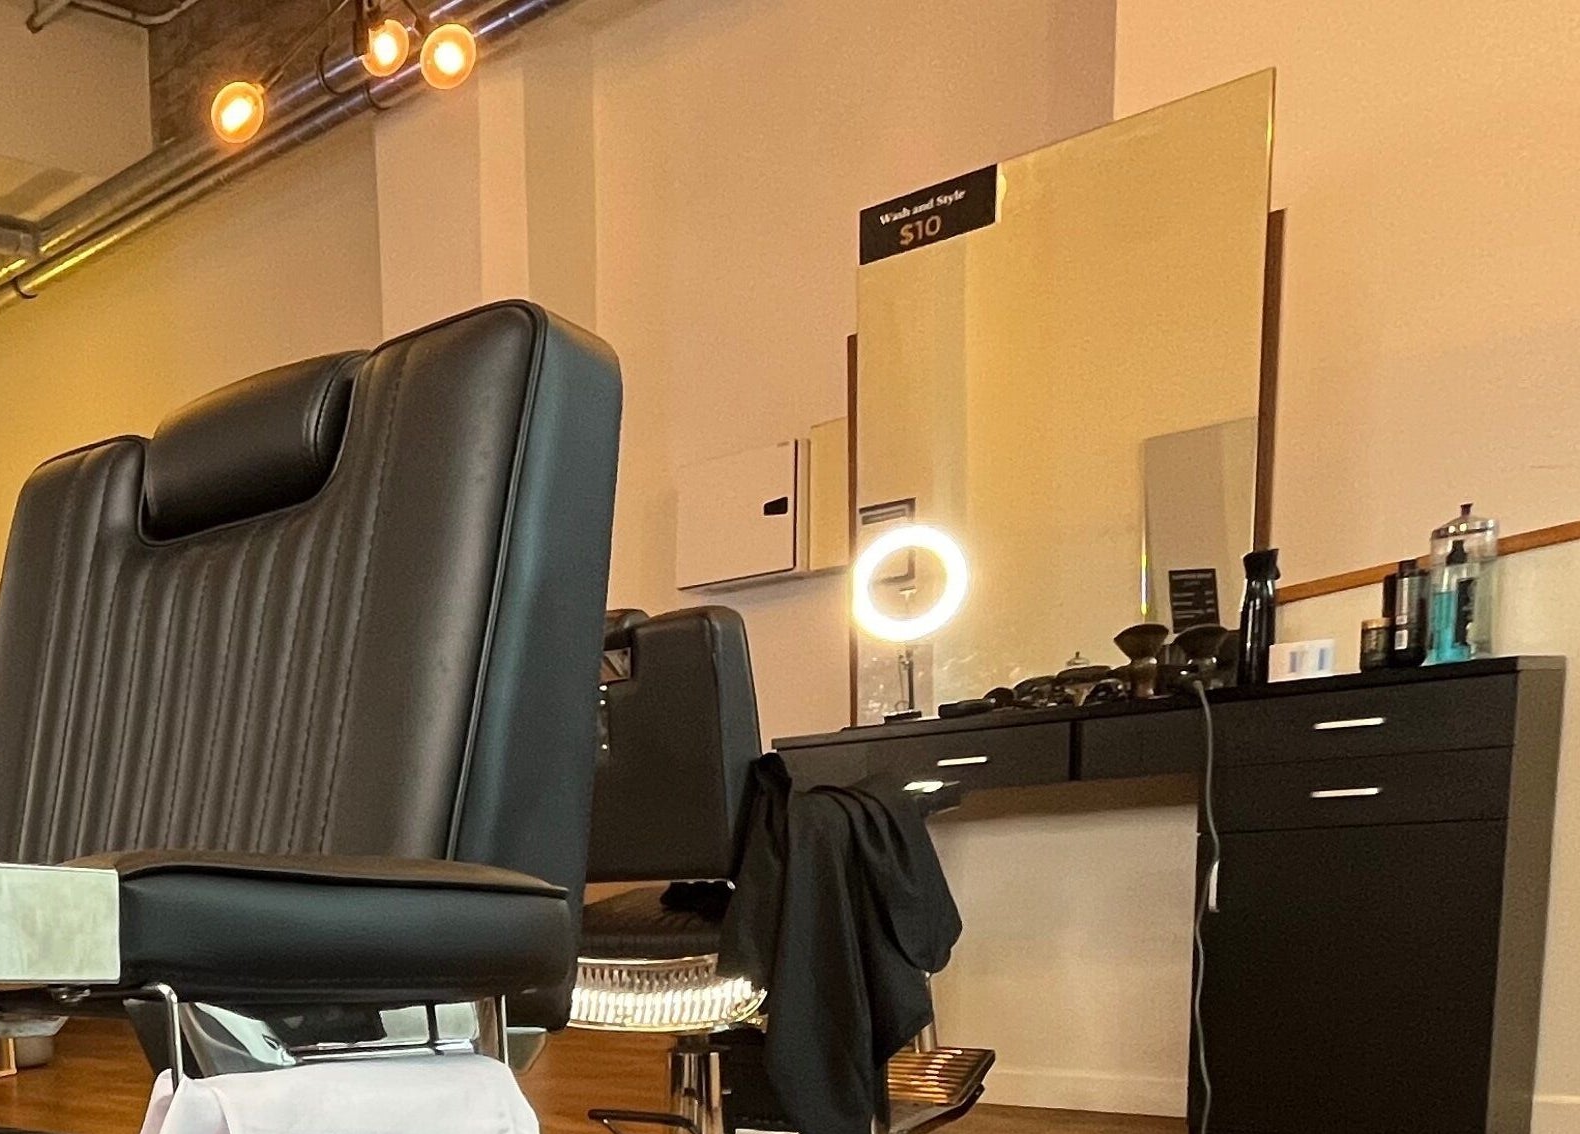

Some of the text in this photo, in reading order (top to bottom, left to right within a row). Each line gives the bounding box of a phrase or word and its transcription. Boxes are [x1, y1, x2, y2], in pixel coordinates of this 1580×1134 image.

[880, 190, 966, 224] Wash and Style
[900, 215, 942, 246] $10
